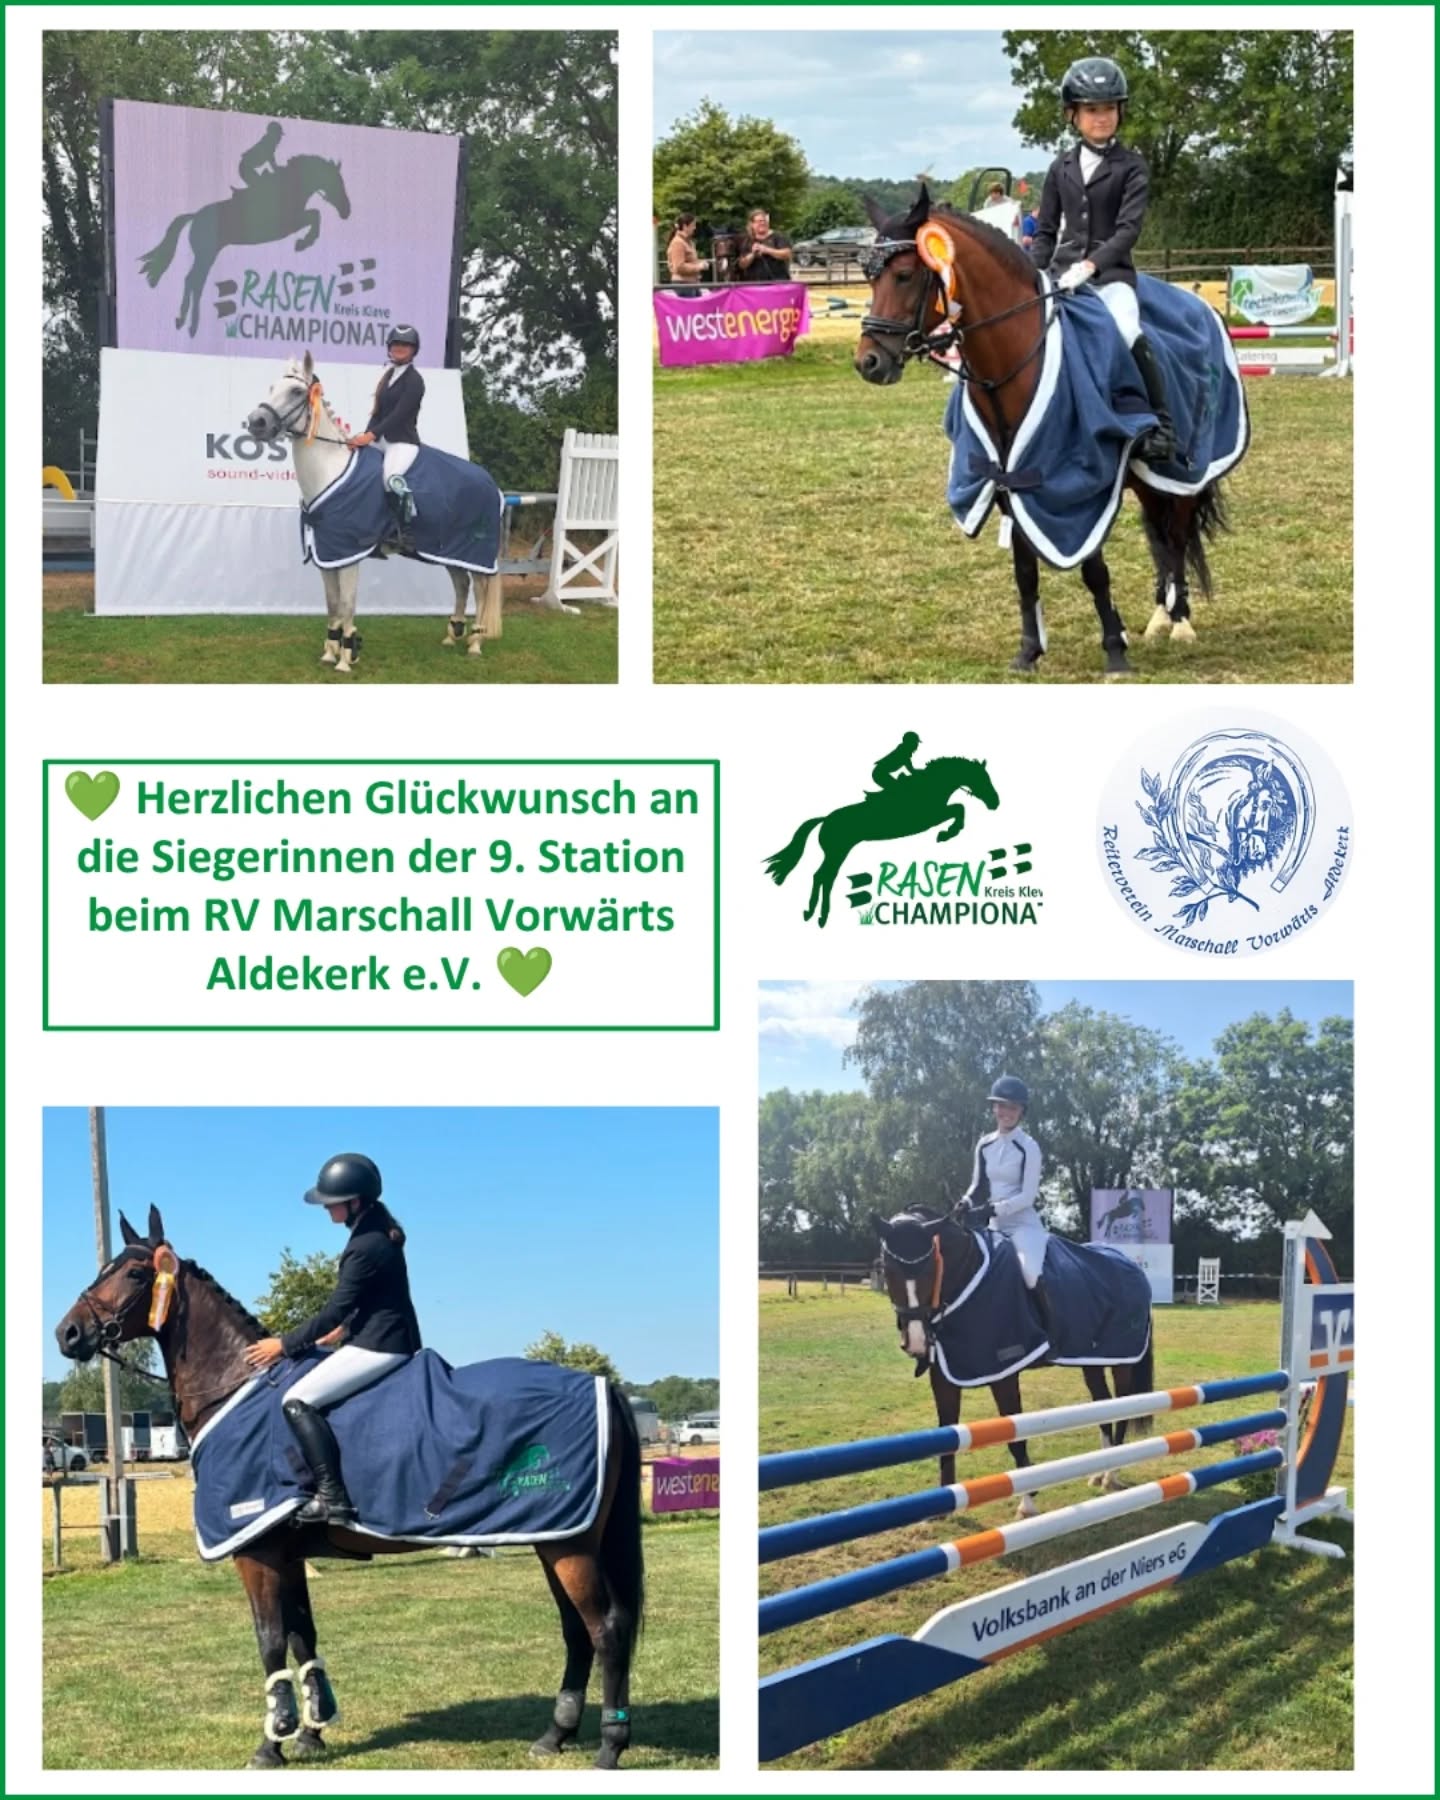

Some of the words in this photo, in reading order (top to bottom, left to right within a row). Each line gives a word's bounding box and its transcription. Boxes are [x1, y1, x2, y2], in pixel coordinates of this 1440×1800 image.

[241, 269, 336, 314] RASEN
[334, 303, 360, 318] Kreis
[239, 313, 390, 346] CHAMPIONAT
[972, 1586, 1071, 1642] Volksbank
[1075, 1579, 1096, 1602] an
[1100, 1568, 1127, 1591] der
[1130, 1554, 1165, 1580] Niers
[1168, 1541, 1187, 1564] eG
